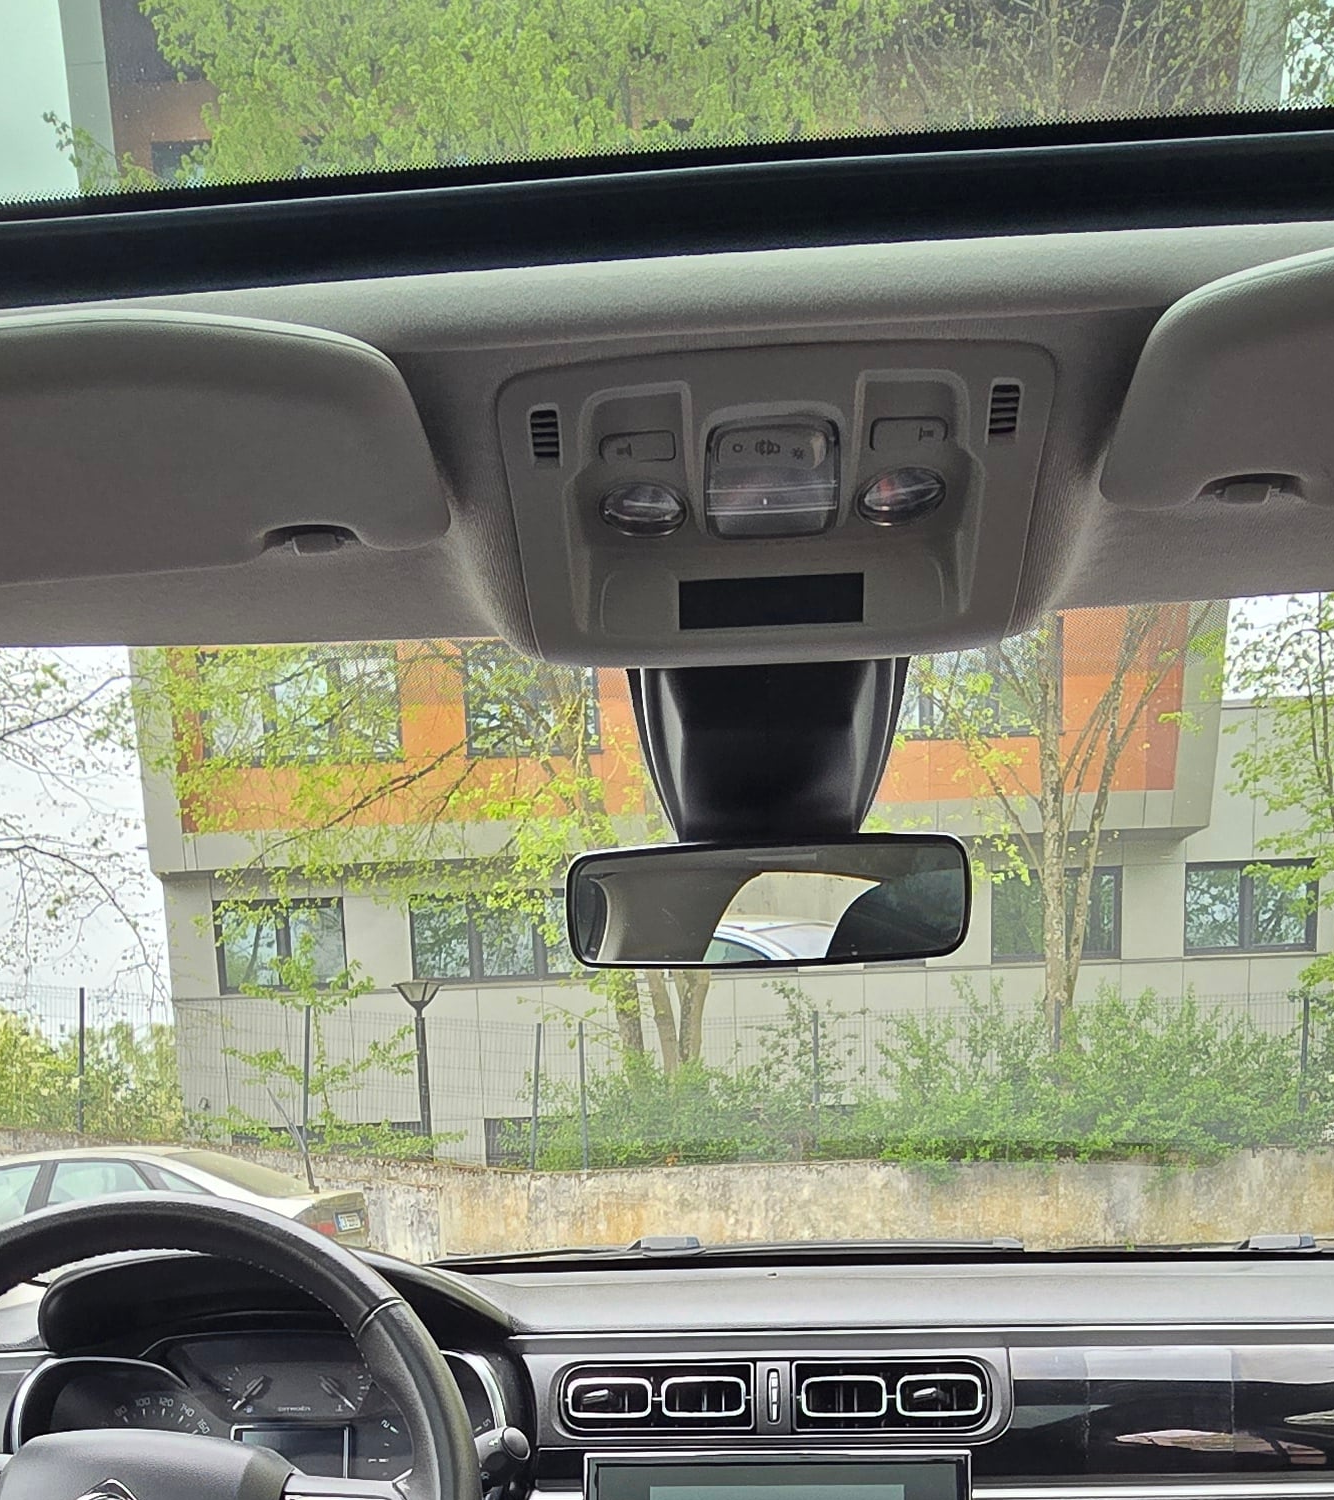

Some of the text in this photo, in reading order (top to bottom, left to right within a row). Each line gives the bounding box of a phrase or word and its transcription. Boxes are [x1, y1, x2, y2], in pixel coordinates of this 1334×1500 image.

[135, 1397, 151, 1407] 100
[159, 1397, 174, 1407] 120
[179, 1403, 195, 1418] 140
[197, 1418, 211, 1434] 160
